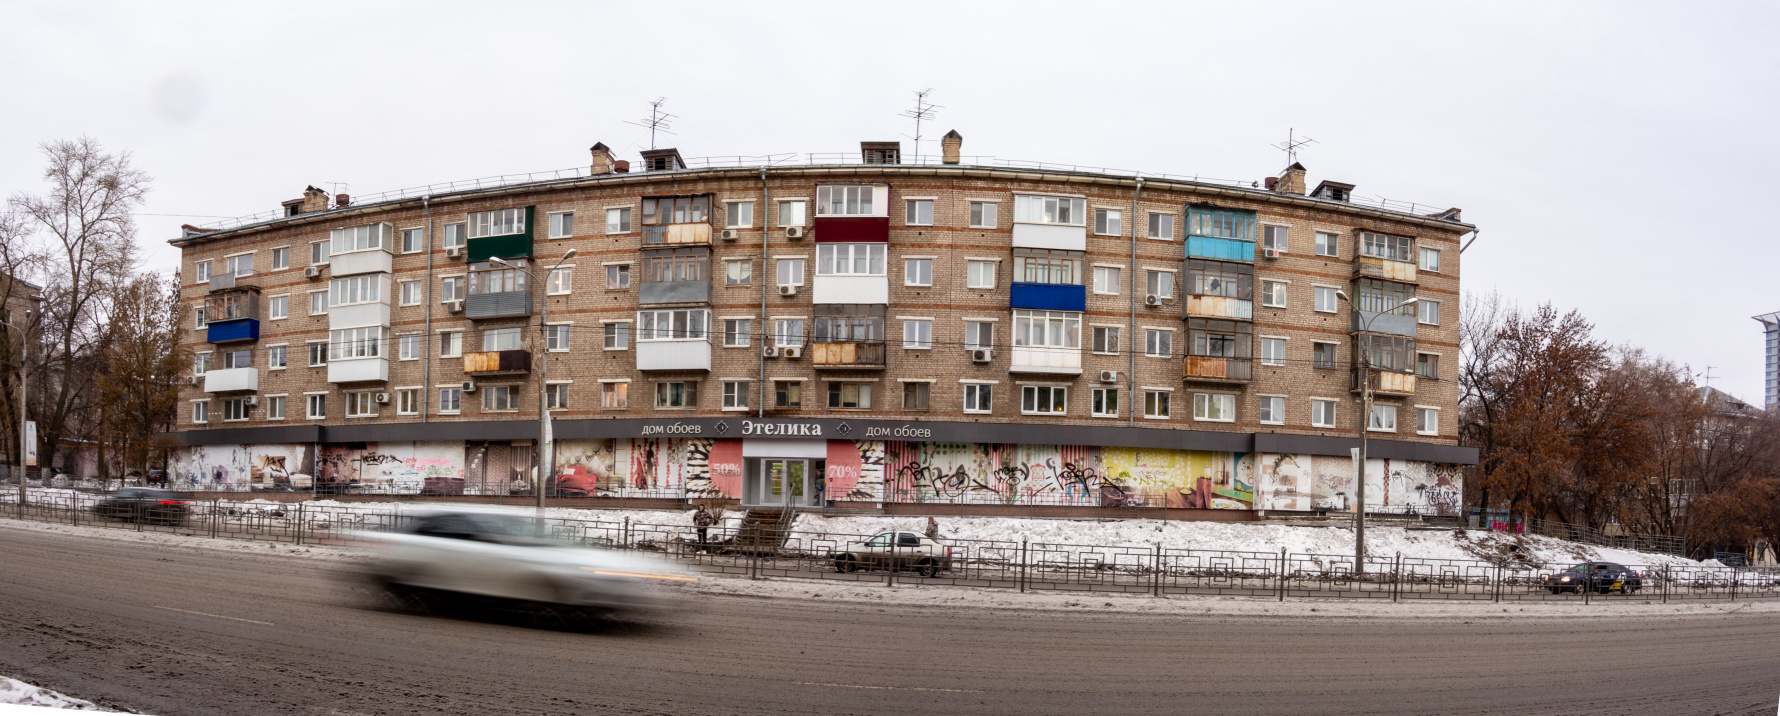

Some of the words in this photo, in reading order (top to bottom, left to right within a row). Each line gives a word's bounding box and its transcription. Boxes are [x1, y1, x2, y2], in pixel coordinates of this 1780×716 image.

[641, 425, 664, 436] дом
[666, 421, 702, 434] обоев
[741, 419, 822, 436] Этелика
[865, 426, 891, 437] дом
[894, 424, 932, 438] обоев
[712, 463, 741, 476] 50%
[828, 464, 858, 478] 70%
